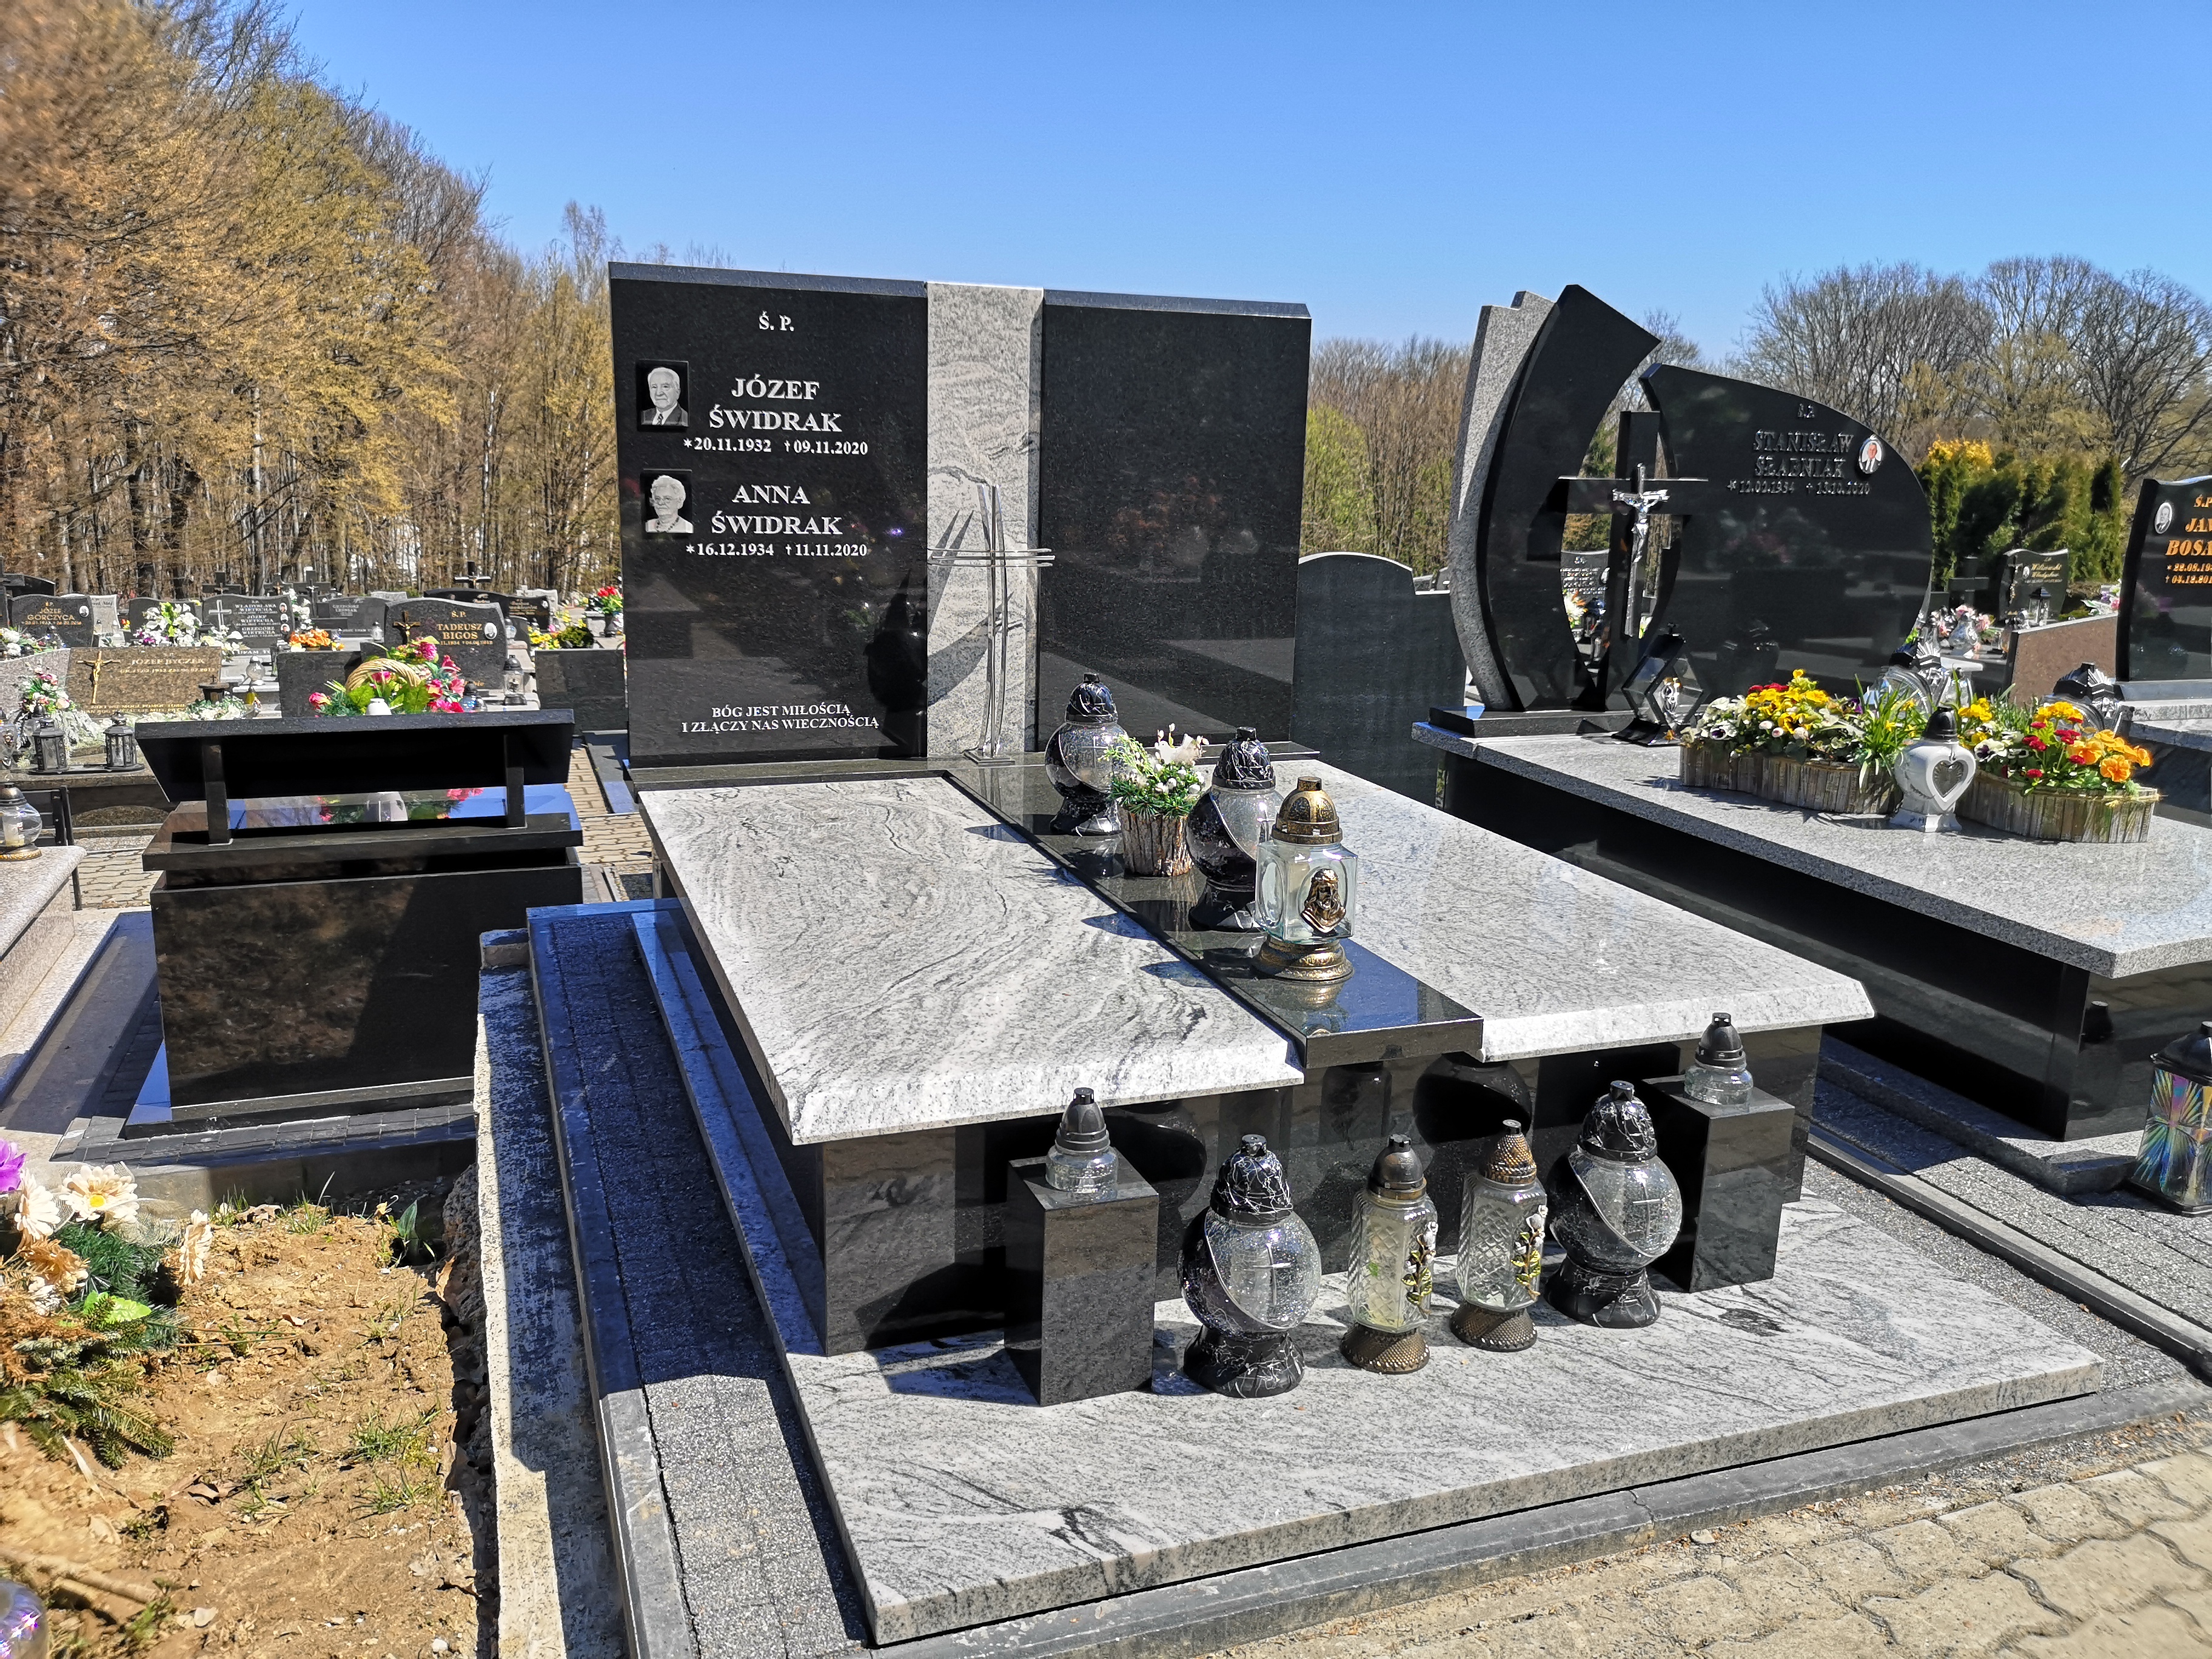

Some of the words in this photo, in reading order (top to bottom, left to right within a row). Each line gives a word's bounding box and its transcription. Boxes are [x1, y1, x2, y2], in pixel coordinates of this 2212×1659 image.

[759, 310, 775, 330] Ś.
[779, 315, 794, 331] P.
[731, 374, 820, 400] JÓZEF
[709, 404, 842, 432] ŚWIDRAK
[694, 437, 772, 453] 20.11.1932
[793, 440, 868, 455] 09.11.2020
[1752, 429, 1854, 454] STANISŁAW
[732, 484, 811, 504] ANNA
[711, 510, 843, 535] ŚWIDRAK
[697, 543, 774, 557] 16.12.1934
[794, 543, 867, 557] 11.11.2020
[2173, 562, 2212, 572] 22.08.19
[443, 631, 478, 640] BIGOS
[711, 704, 743, 718] BÓG
[745, 705, 779, 717] JEST
[781, 701, 851, 717] MIŁOŚCIĄ
[681, 722, 689, 732] I
[690, 720, 749, 735] ZŁĄCZY
[751, 719, 779, 731] NAS
[781, 714, 879, 729] WIECZNOŚCIĄ
